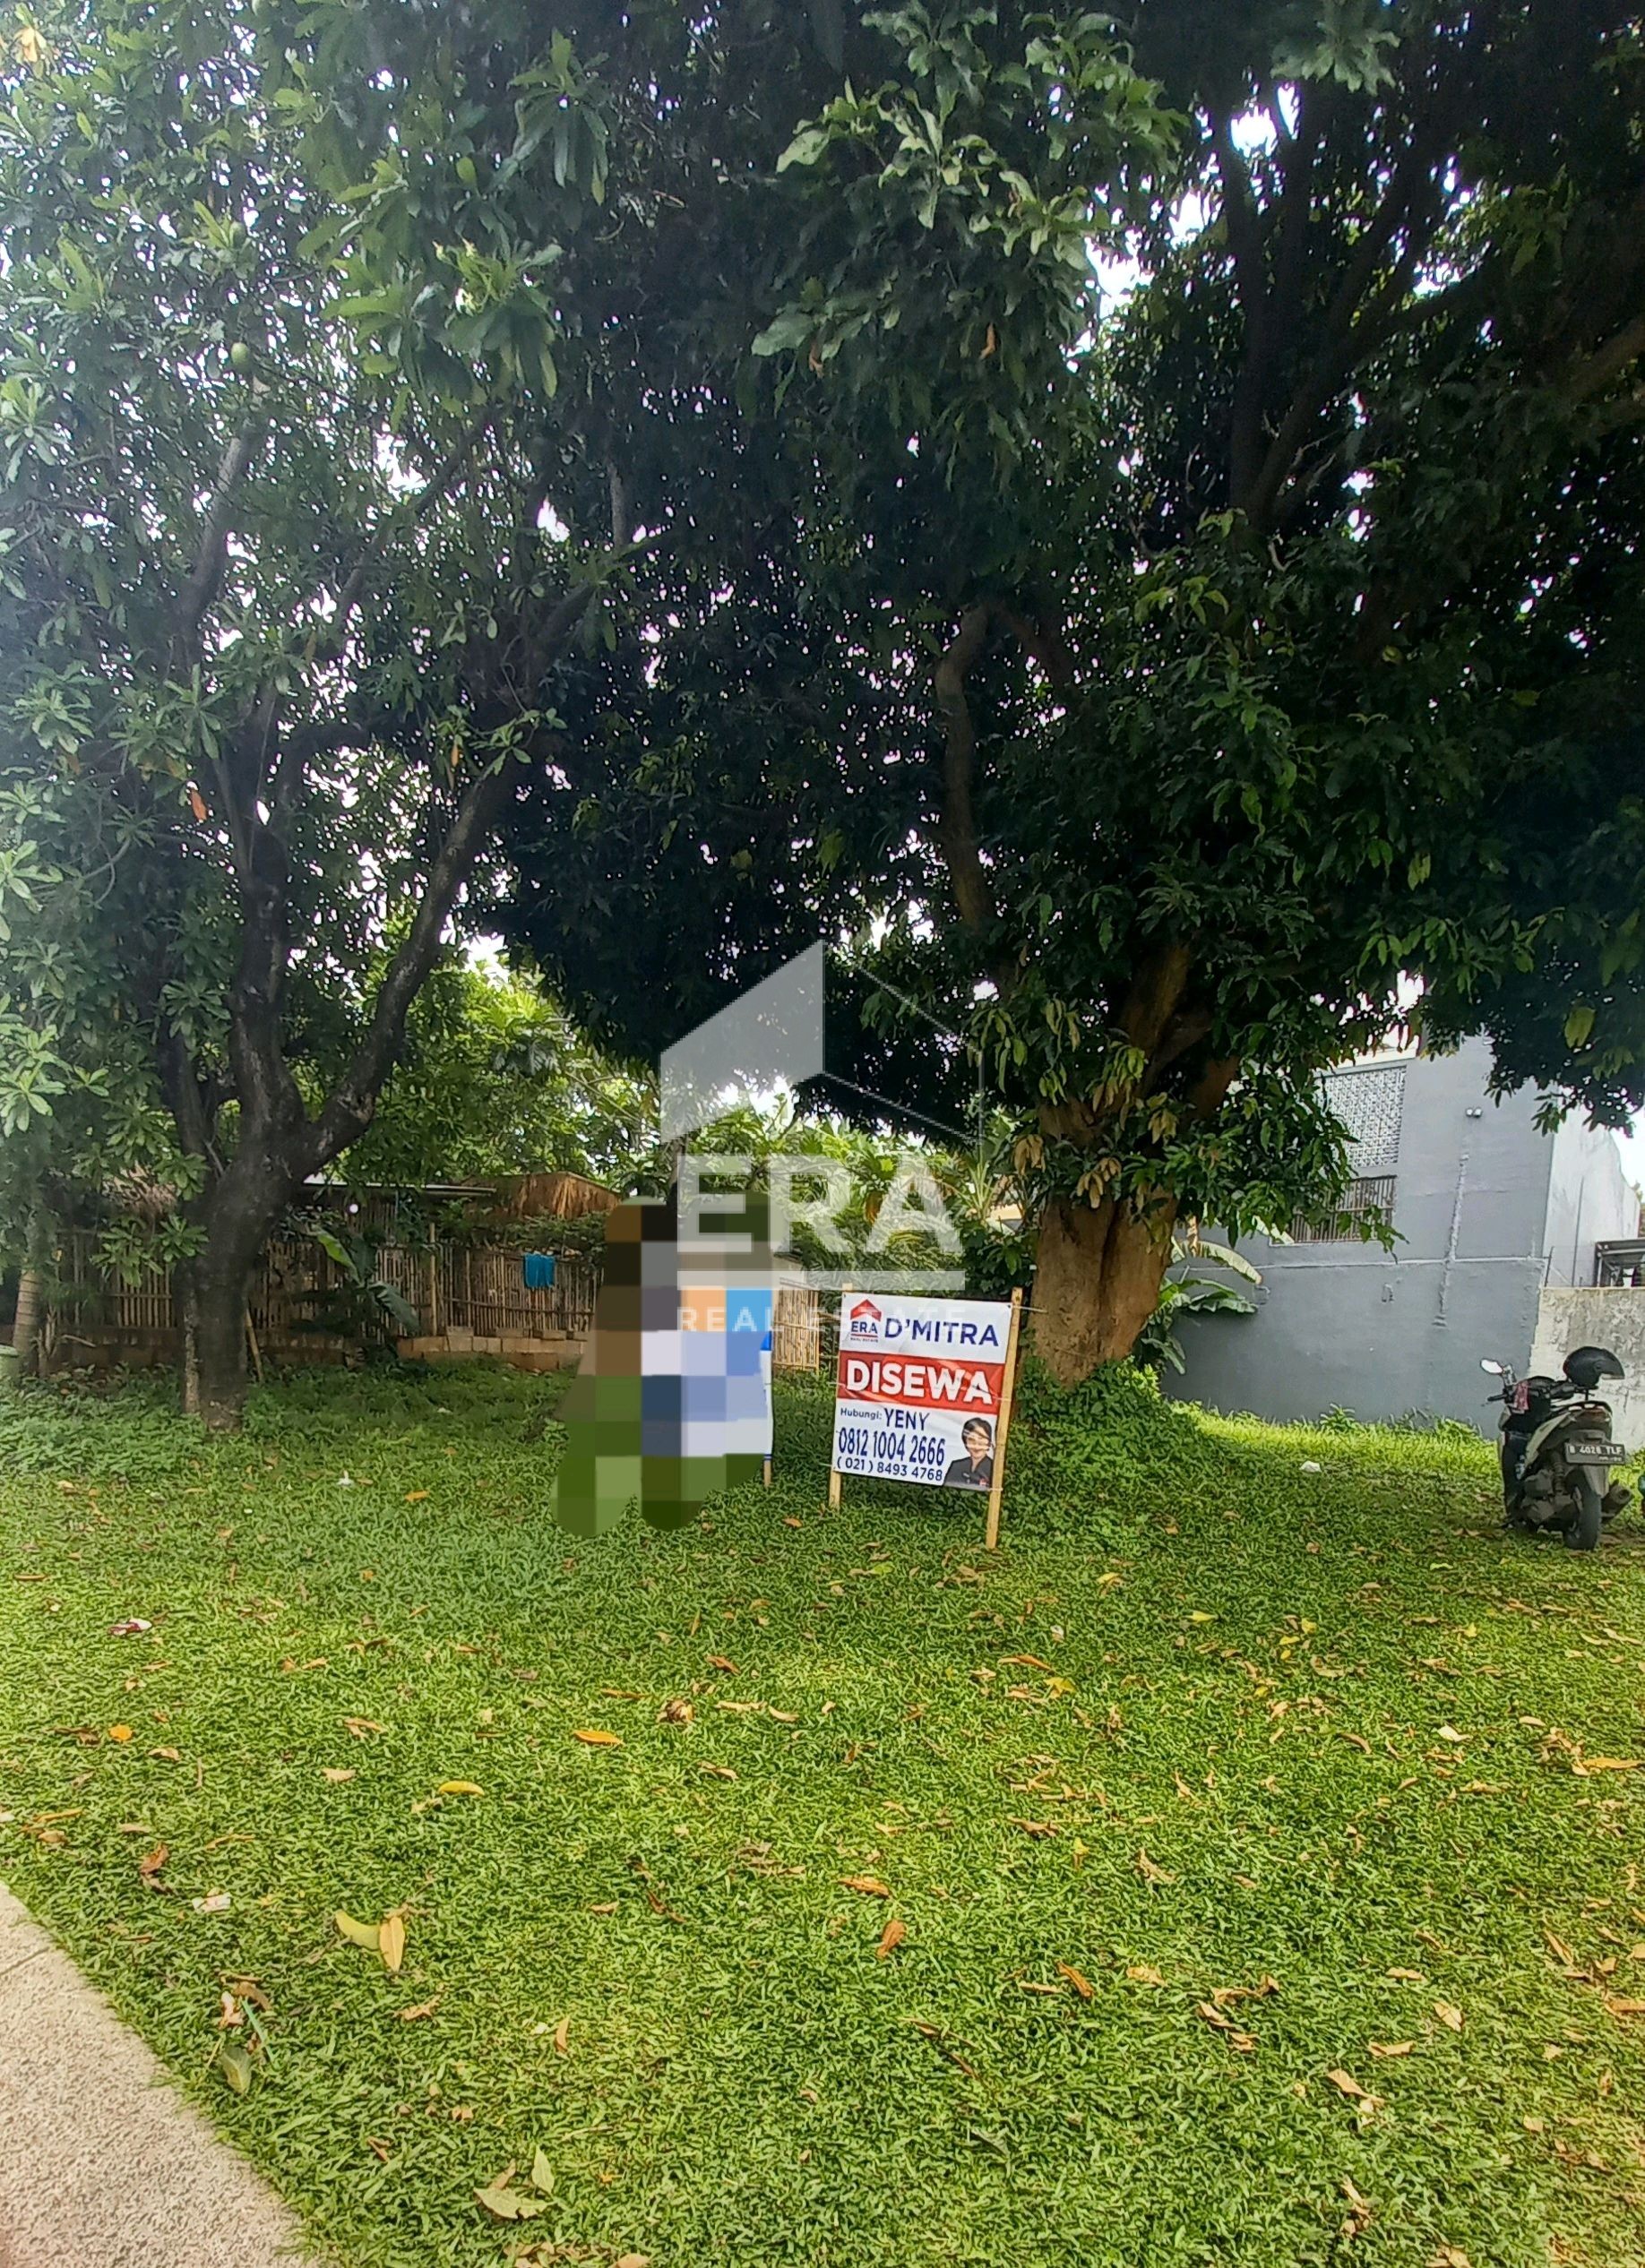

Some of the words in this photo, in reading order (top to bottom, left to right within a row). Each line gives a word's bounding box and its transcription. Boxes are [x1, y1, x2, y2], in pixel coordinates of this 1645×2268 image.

[851, 1320, 878, 1335] ERA
[847, 1360, 993, 1405] DISEWA
[840, 1407, 882, 1421] Hubungi:
[883, 1408, 930, 1430] YENY
[839, 1426, 867, 1458] 0812
[873, 1431, 905, 1462] 1004
[909, 1436, 945, 1465] 2666
[877, 1462, 907, 1476] 8493
[911, 1466, 943, 1481] 4768
